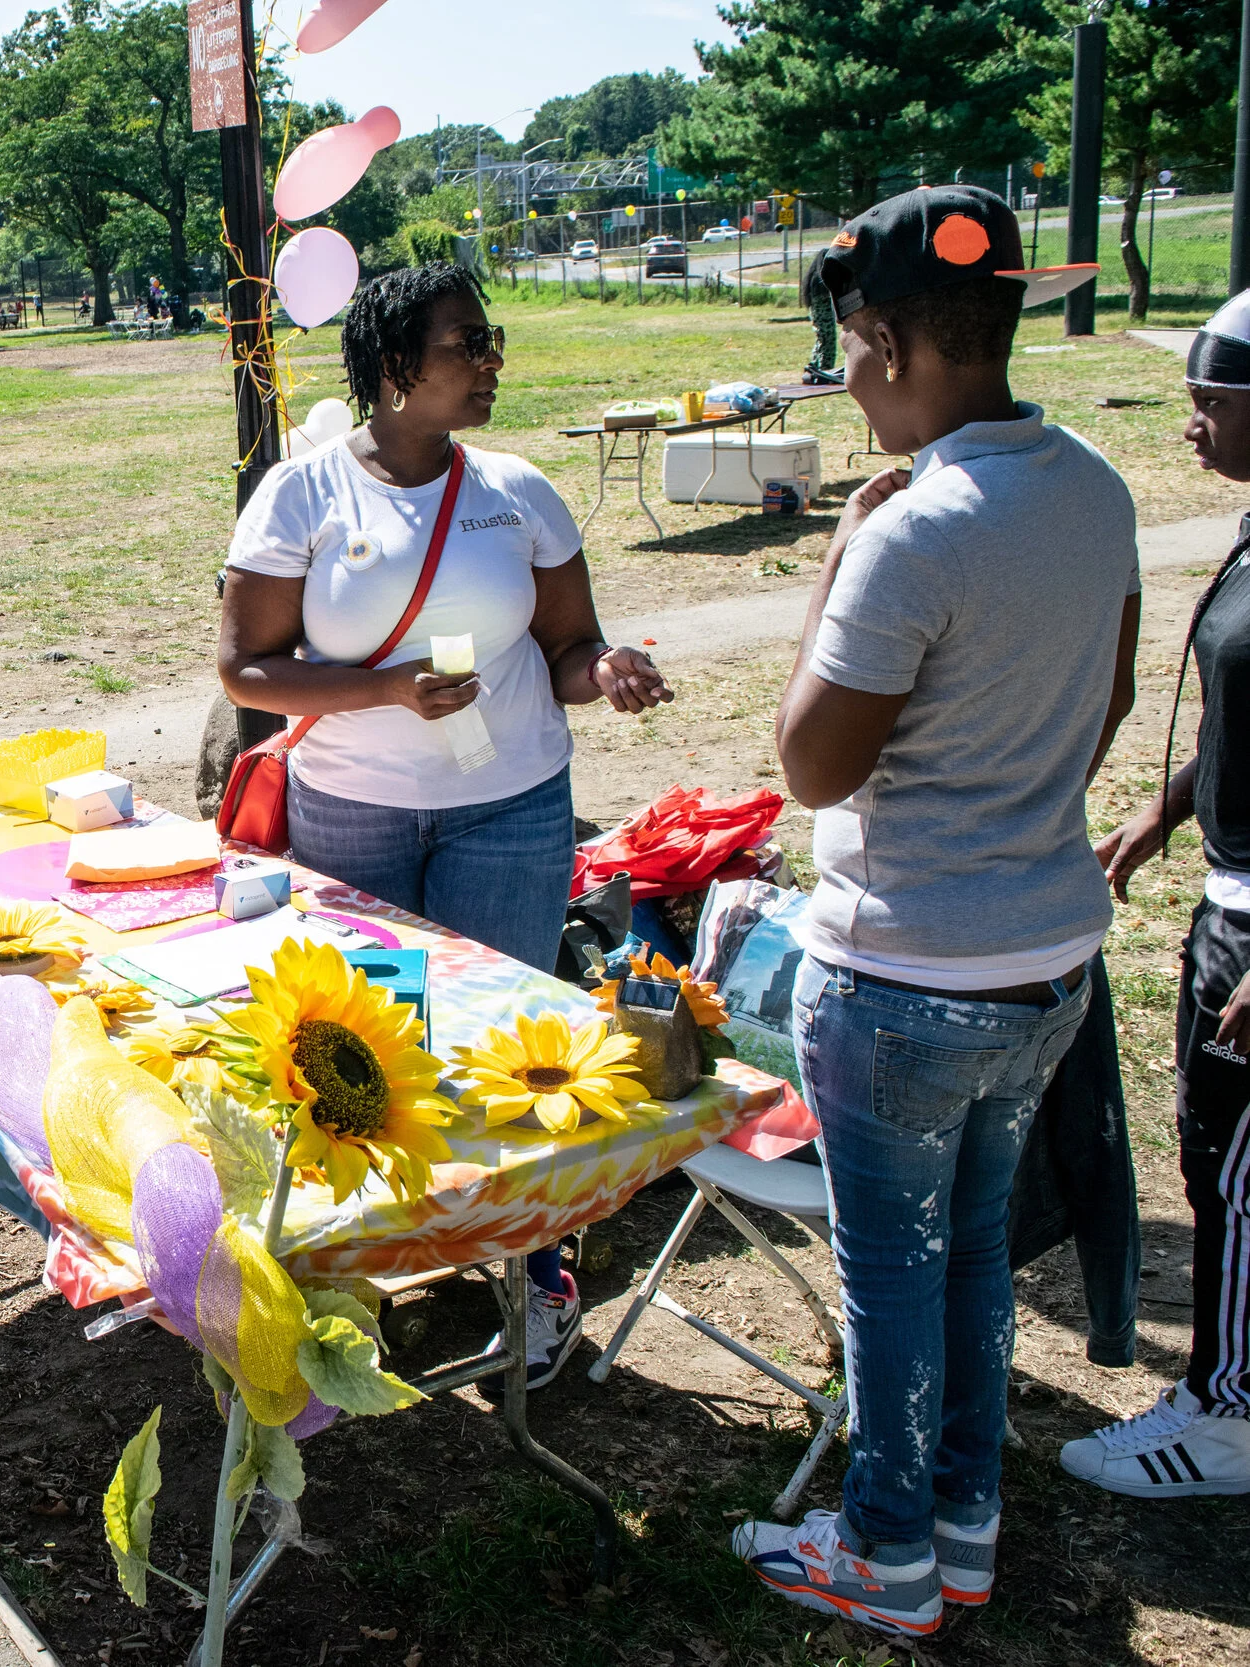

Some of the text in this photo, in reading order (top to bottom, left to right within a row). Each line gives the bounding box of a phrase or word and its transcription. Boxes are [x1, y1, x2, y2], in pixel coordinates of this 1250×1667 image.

[206, 25, 238, 47] LITTERING
[191, 23, 206, 72] NO
[780, 211, 793, 219] 20
[458, 512, 522, 533] Hustla
[1201, 1042, 1247, 1065] adidas
[950, 1543, 988, 1565] NIKE
